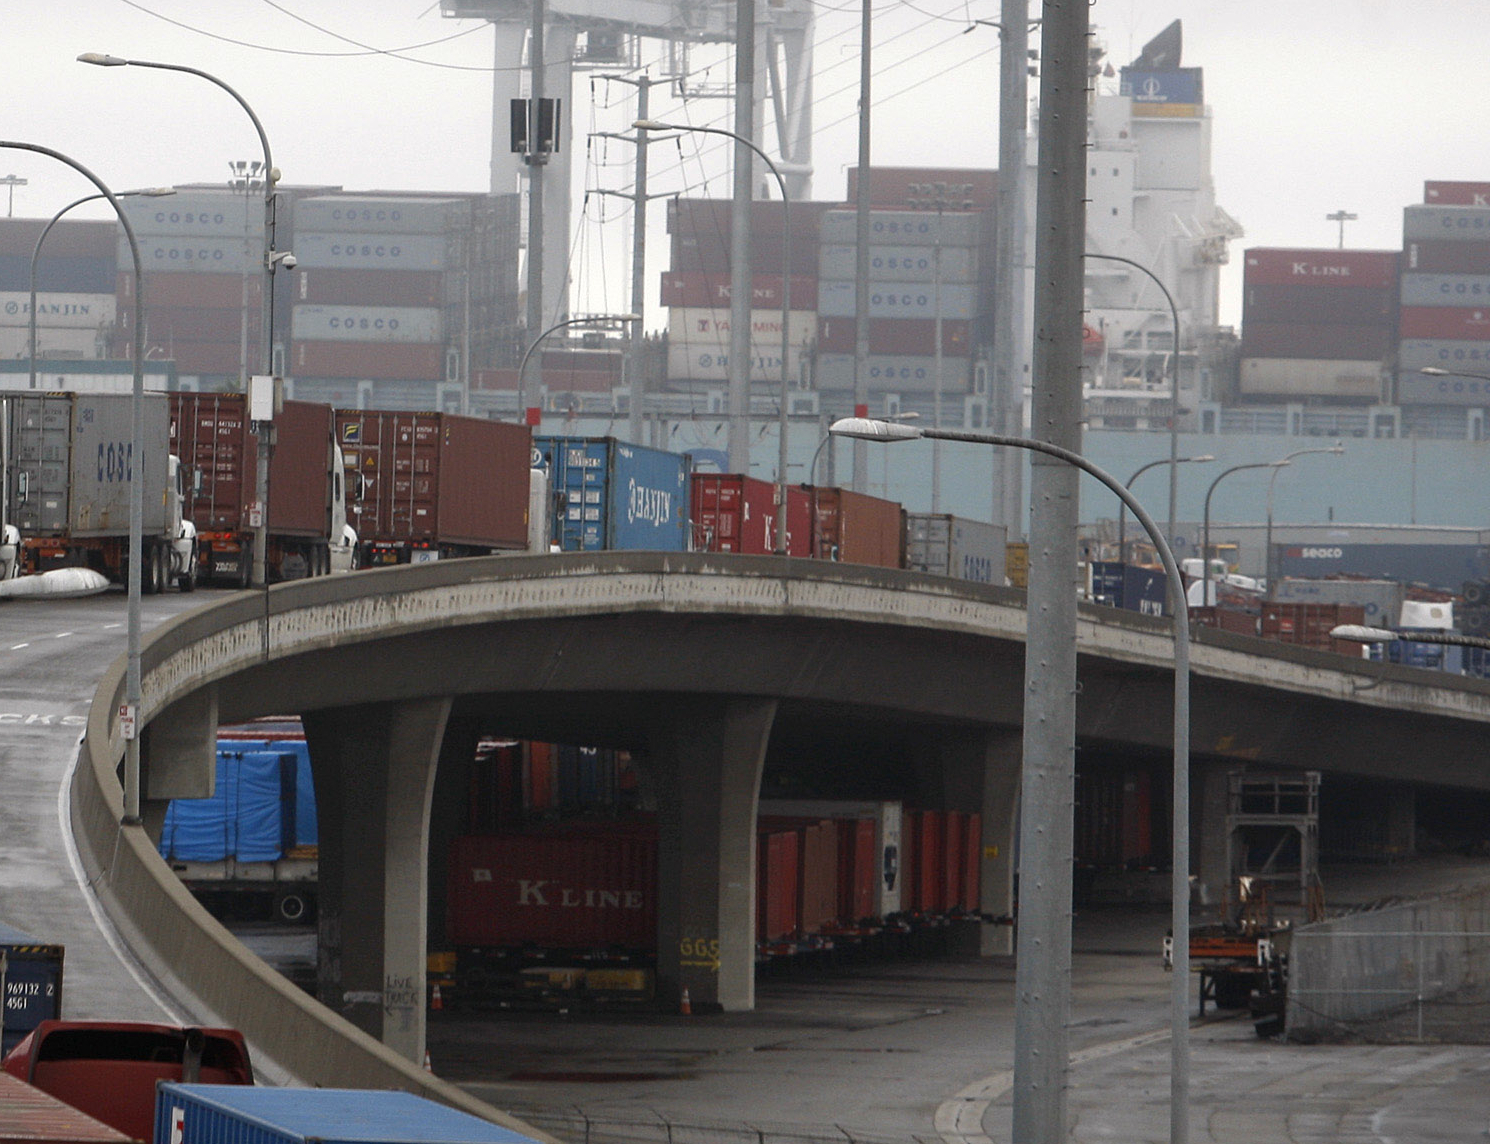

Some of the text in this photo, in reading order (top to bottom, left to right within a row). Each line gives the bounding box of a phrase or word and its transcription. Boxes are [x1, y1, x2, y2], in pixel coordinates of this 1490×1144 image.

[154, 212, 224, 224] COSCO
[332, 209, 401, 221] COSCO
[873, 221, 929, 234] OSCO
[1442, 216, 1490, 229] COS
[155, 248, 224, 260] COSCO
[331, 244, 401, 257] COSCO
[872, 257, 928, 269] OSCO
[1311, 265, 1350, 276] LINE
[871, 294, 928, 306] OSCO
[22, 304, 90, 316] HANJIN
[329, 316, 399, 330] COSCO
[717, 355, 783, 368] HJIN
[870, 366, 926, 379] OSCO
[97, 441, 144, 483] COSC
[1302, 547, 1343, 559] seaco
[562, 888, 644, 909] LINE
[7, 982, 39, 996] 969132
[46, 984, 54, 997] 2
[7, 997, 27, 1010] 45G1
